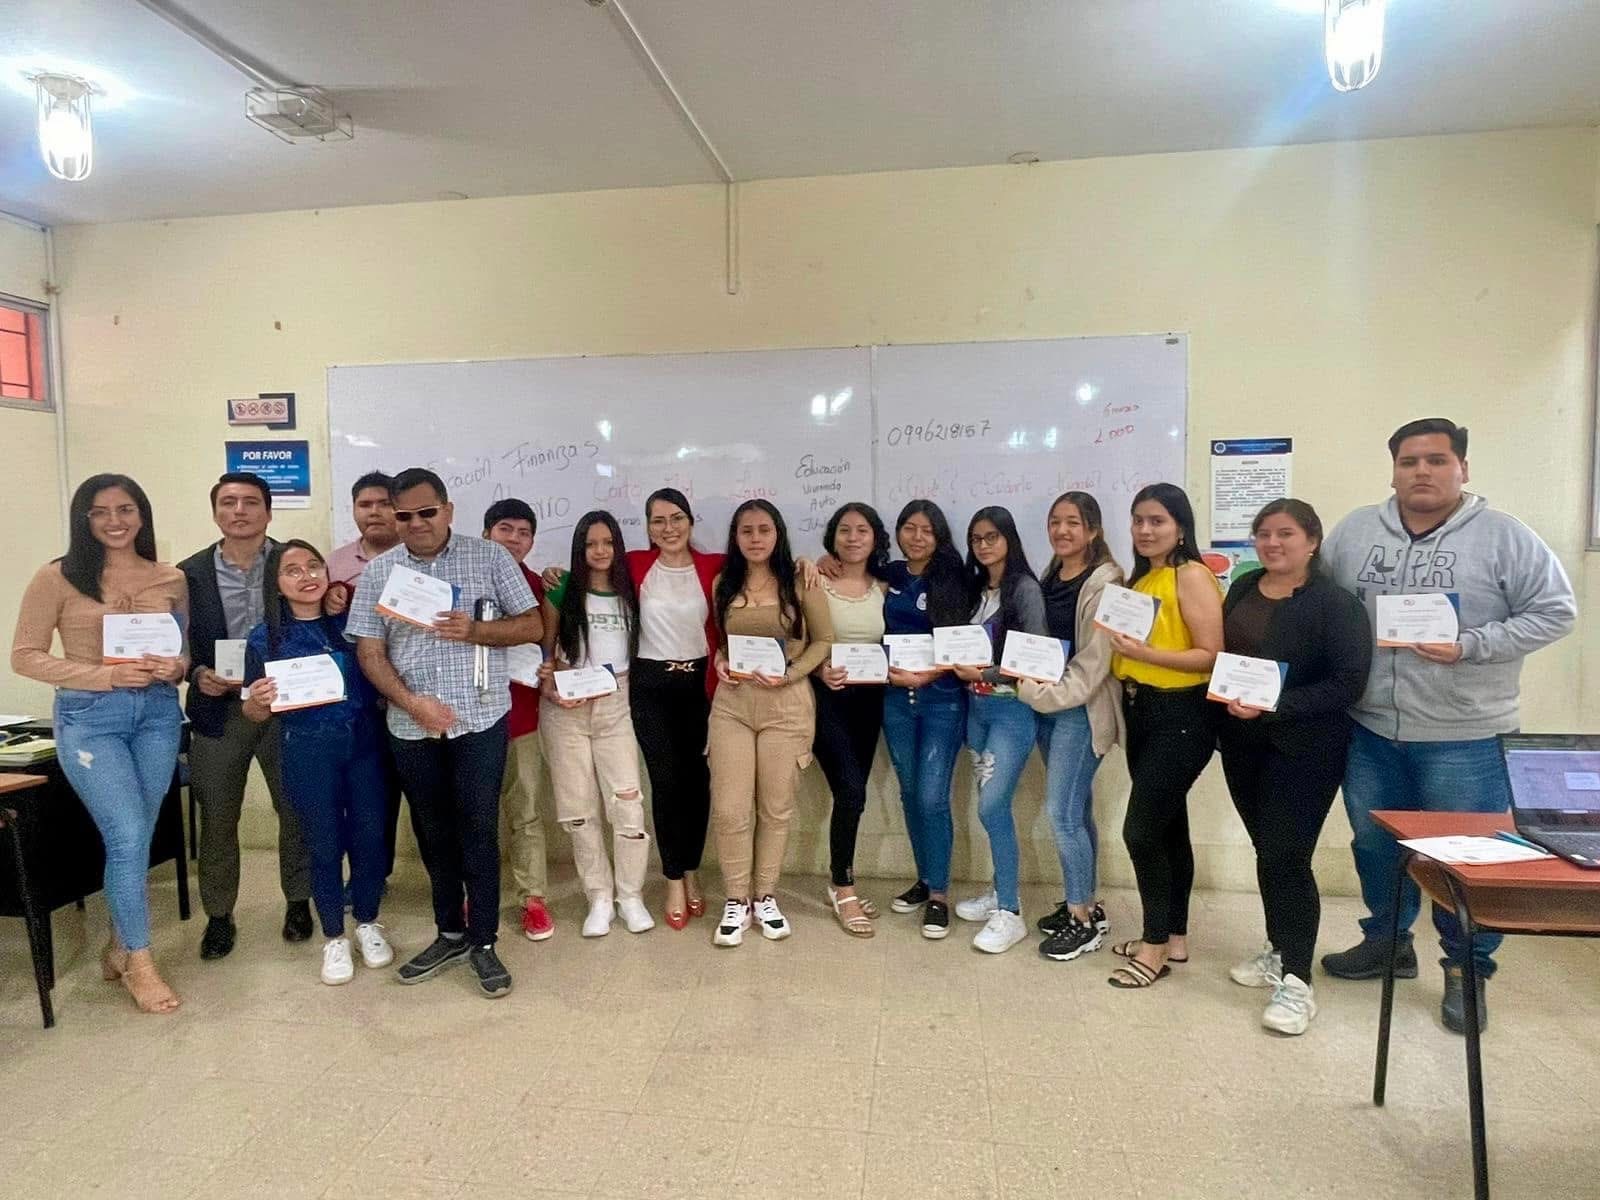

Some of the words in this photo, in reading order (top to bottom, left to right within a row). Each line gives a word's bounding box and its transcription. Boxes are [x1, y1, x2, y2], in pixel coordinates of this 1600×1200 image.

[243, 451, 261, 460] POR
[262, 451, 292, 460] FAVOR
[501, 441, 600, 478] Finanzas
